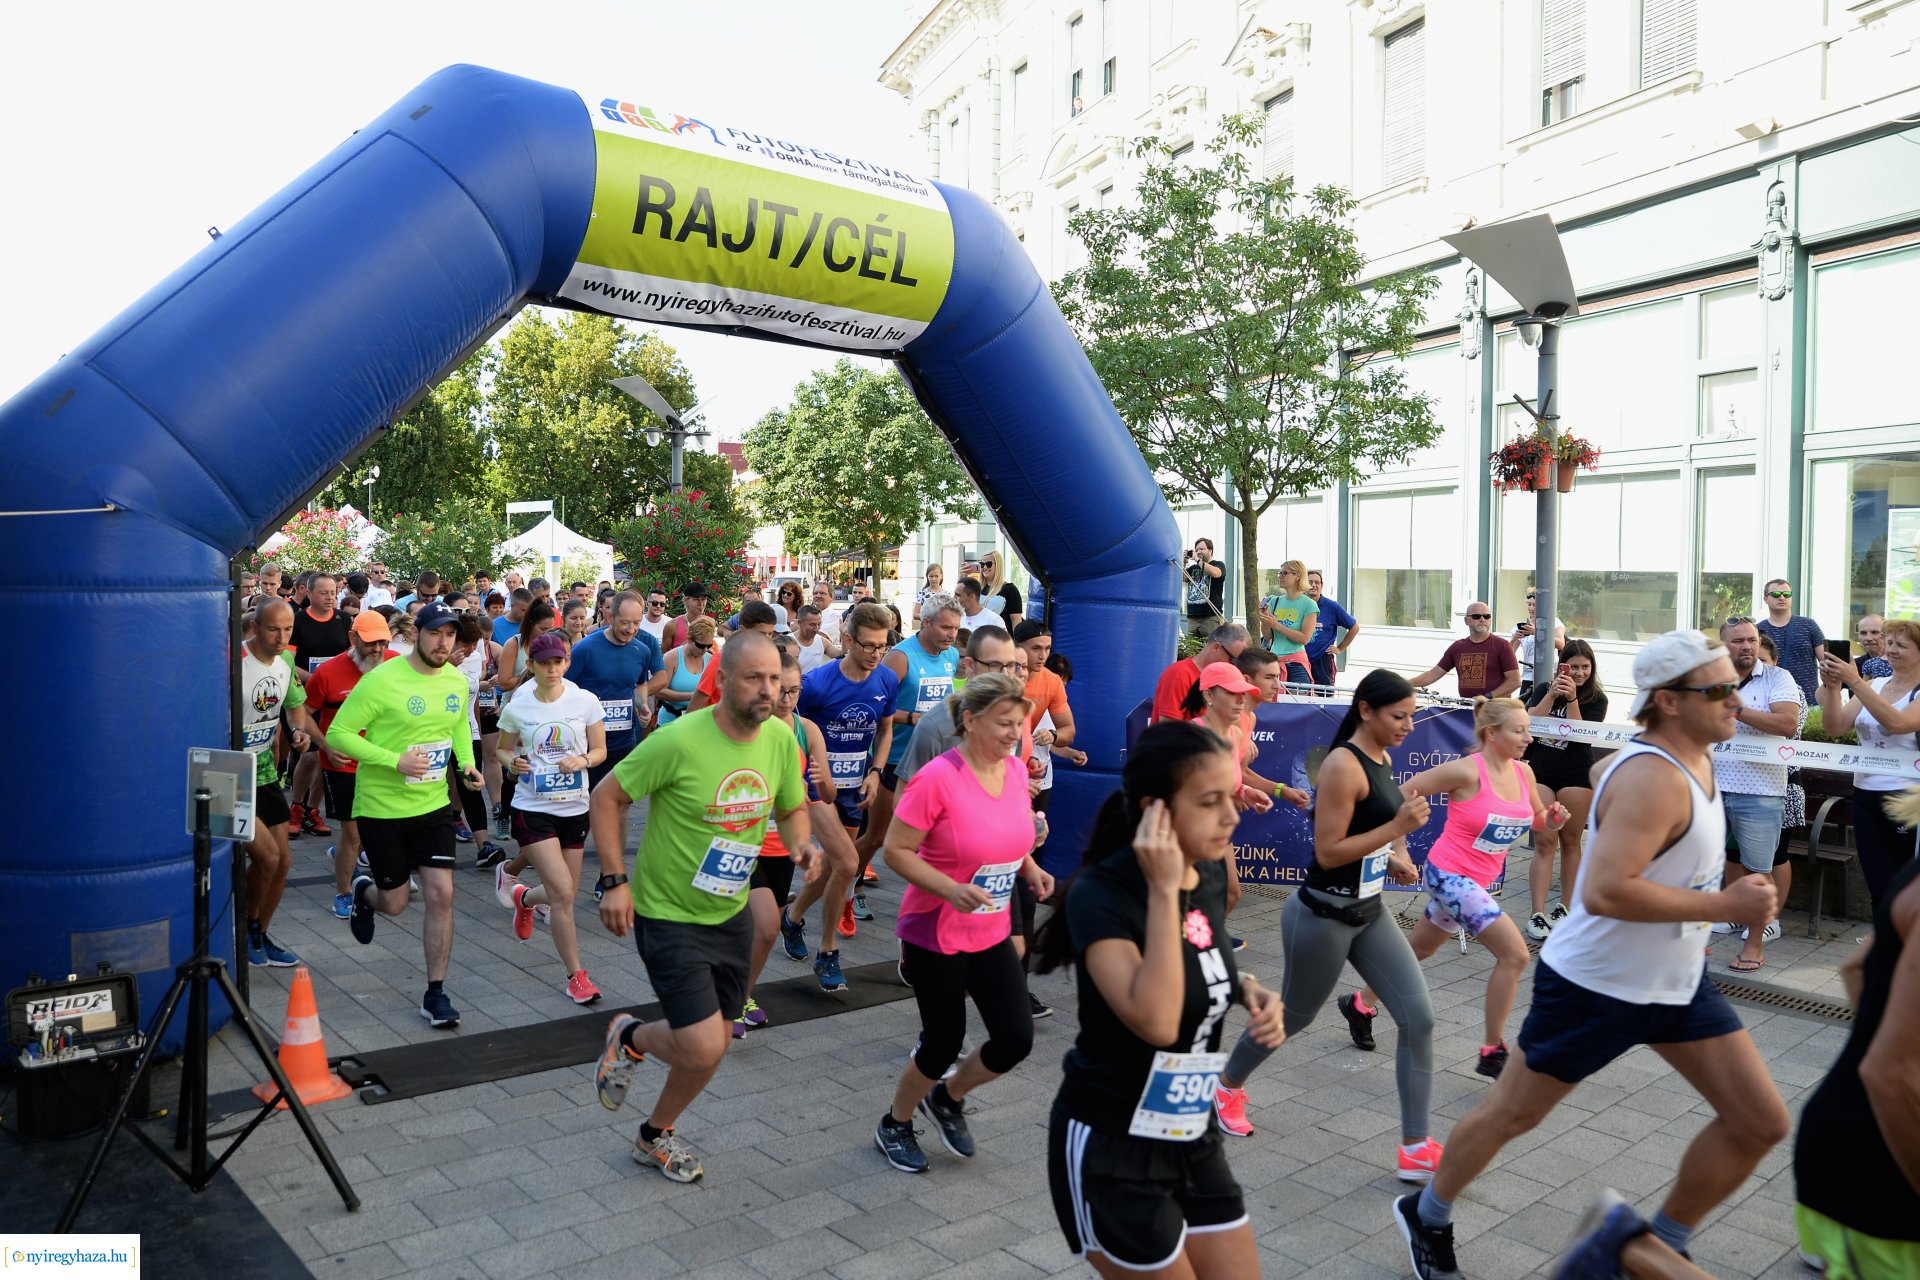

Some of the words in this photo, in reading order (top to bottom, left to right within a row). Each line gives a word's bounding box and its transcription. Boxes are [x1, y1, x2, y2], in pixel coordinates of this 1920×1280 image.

[736, 142, 753, 153] az
[842, 168, 929, 197] támogatásával
[631, 174, 919, 288] RAJT/CÉL
[582, 278, 907, 343] www.nyiregyhazifutofesztival.hu
[926, 685, 948, 698] 587
[606, 707, 628, 718] 584
[246, 728, 271, 744] 536
[1572, 728, 1599, 736] MOZAIK
[1795, 750, 1830, 760] MOZAIK
[832, 761, 860, 774] 654
[545, 773, 575, 788] 523
[238, 819, 248, 834] 7
[1493, 826, 1523, 840] 653
[718, 853, 756, 875] 504
[1258, 866, 1270, 879] A
[984, 872, 1017, 893] 503
[1165, 1073, 1220, 1105] 590
